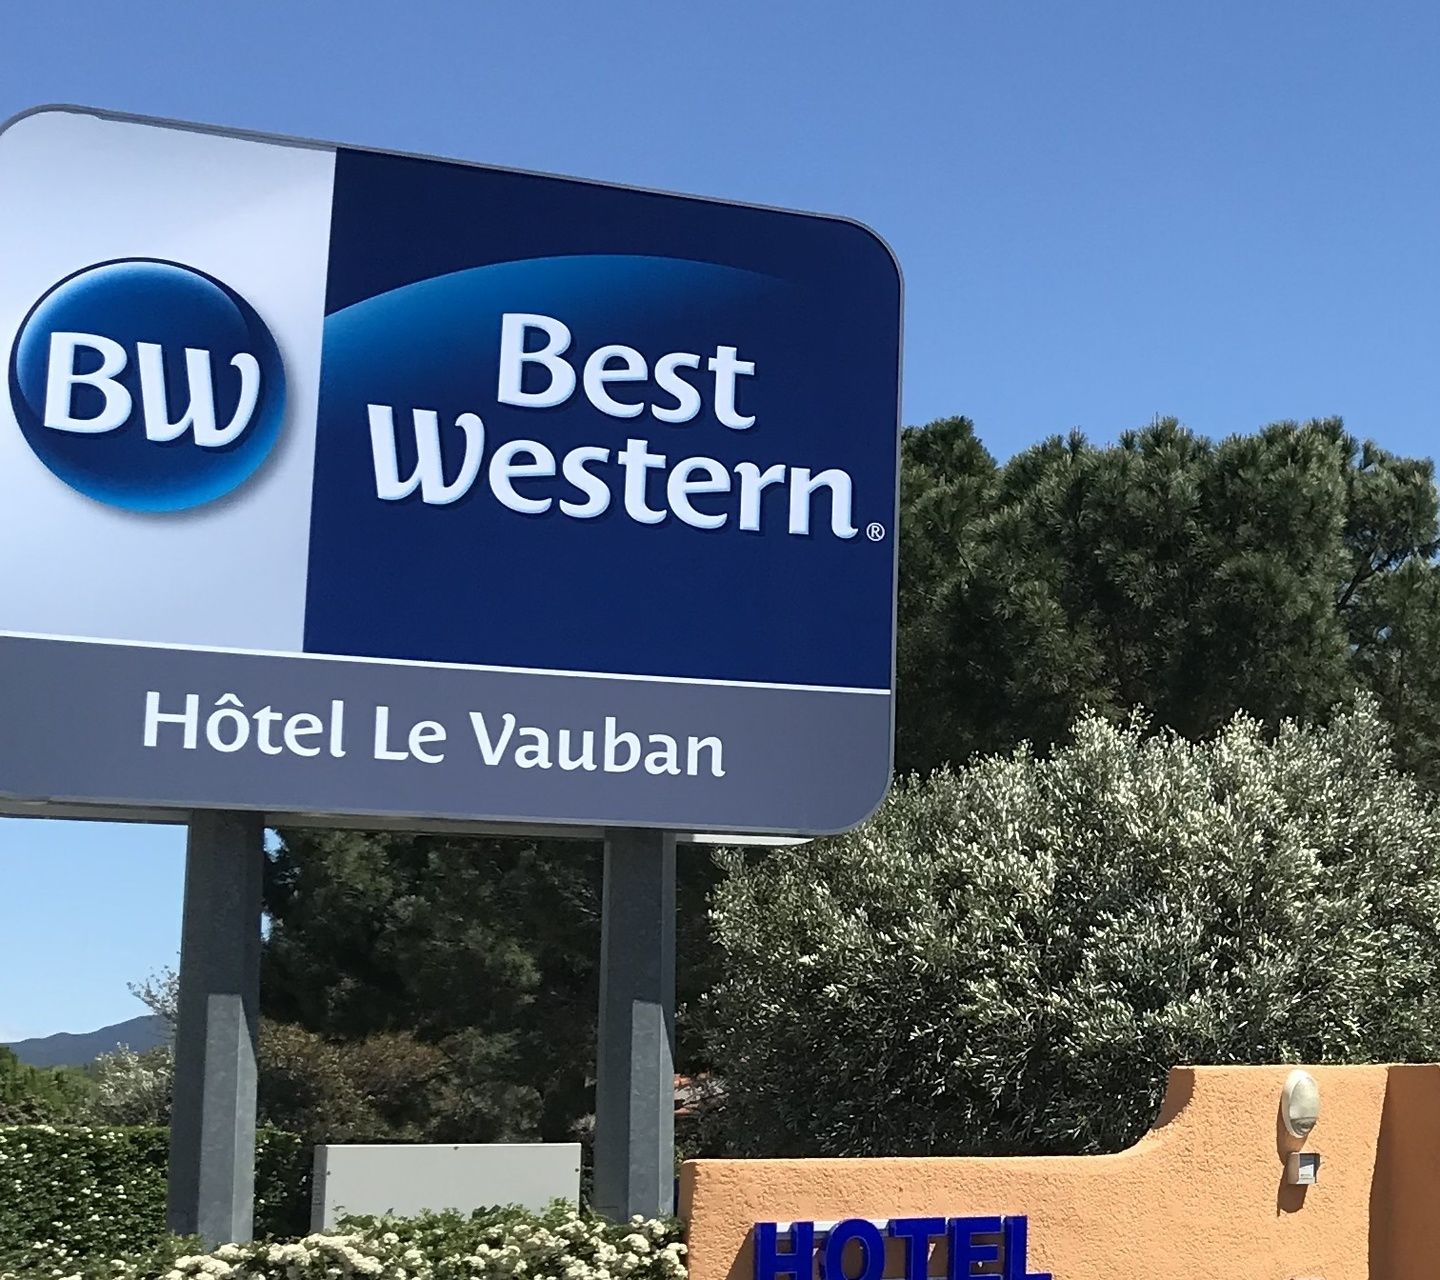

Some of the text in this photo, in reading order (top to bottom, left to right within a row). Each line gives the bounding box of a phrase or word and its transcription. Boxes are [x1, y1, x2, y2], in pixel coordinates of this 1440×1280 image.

[43, 331, 261, 448] BW
[497, 312, 756, 430] Best
[143, 691, 727, 778] Hôtel Le Vauban
